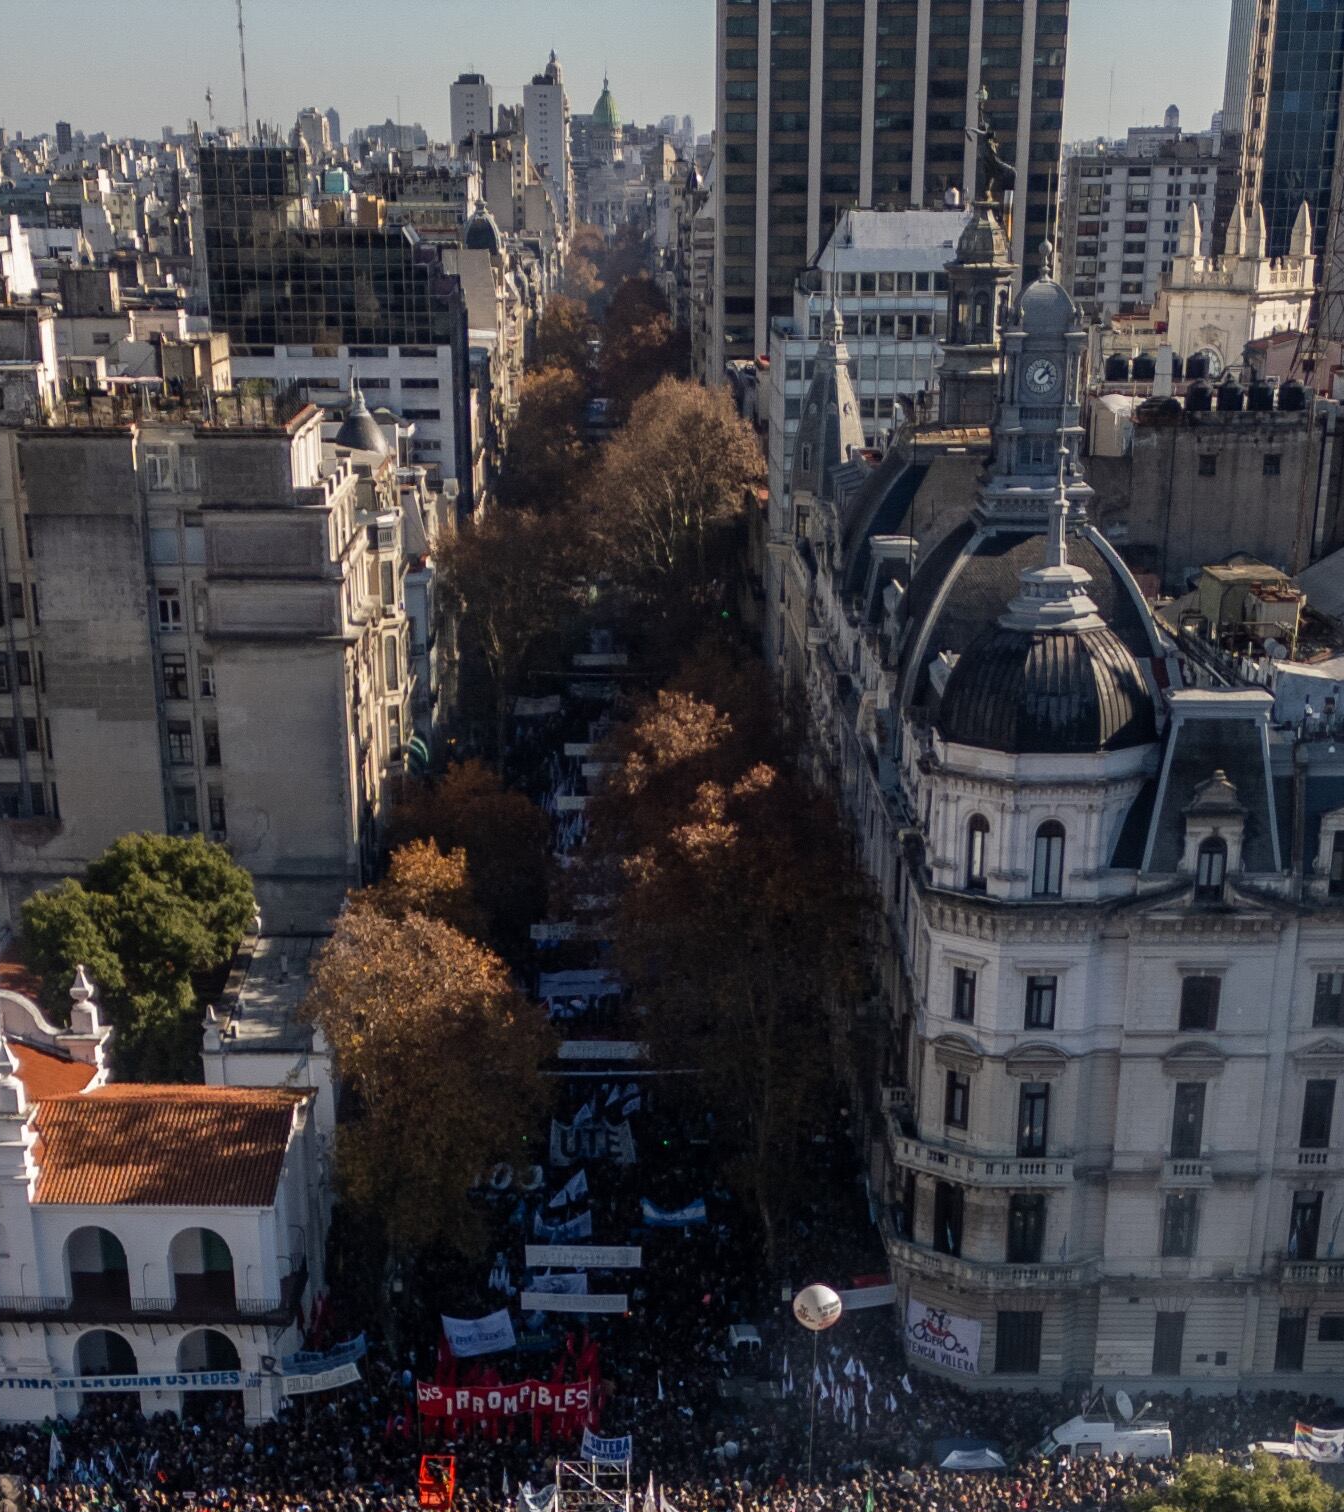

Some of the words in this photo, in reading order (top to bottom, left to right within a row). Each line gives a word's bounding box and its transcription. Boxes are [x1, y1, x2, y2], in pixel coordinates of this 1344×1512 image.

[940, 1350, 976, 1373] VILLERA
[81, 1376, 105, 1388] LA
[109, 1374, 161, 1387] ODIAN
[166, 1371, 240, 1387] USTEDES
[446, 1384, 590, 1416] IRROMPIBLES
[590, 1436, 630, 1452] SUTEBA
